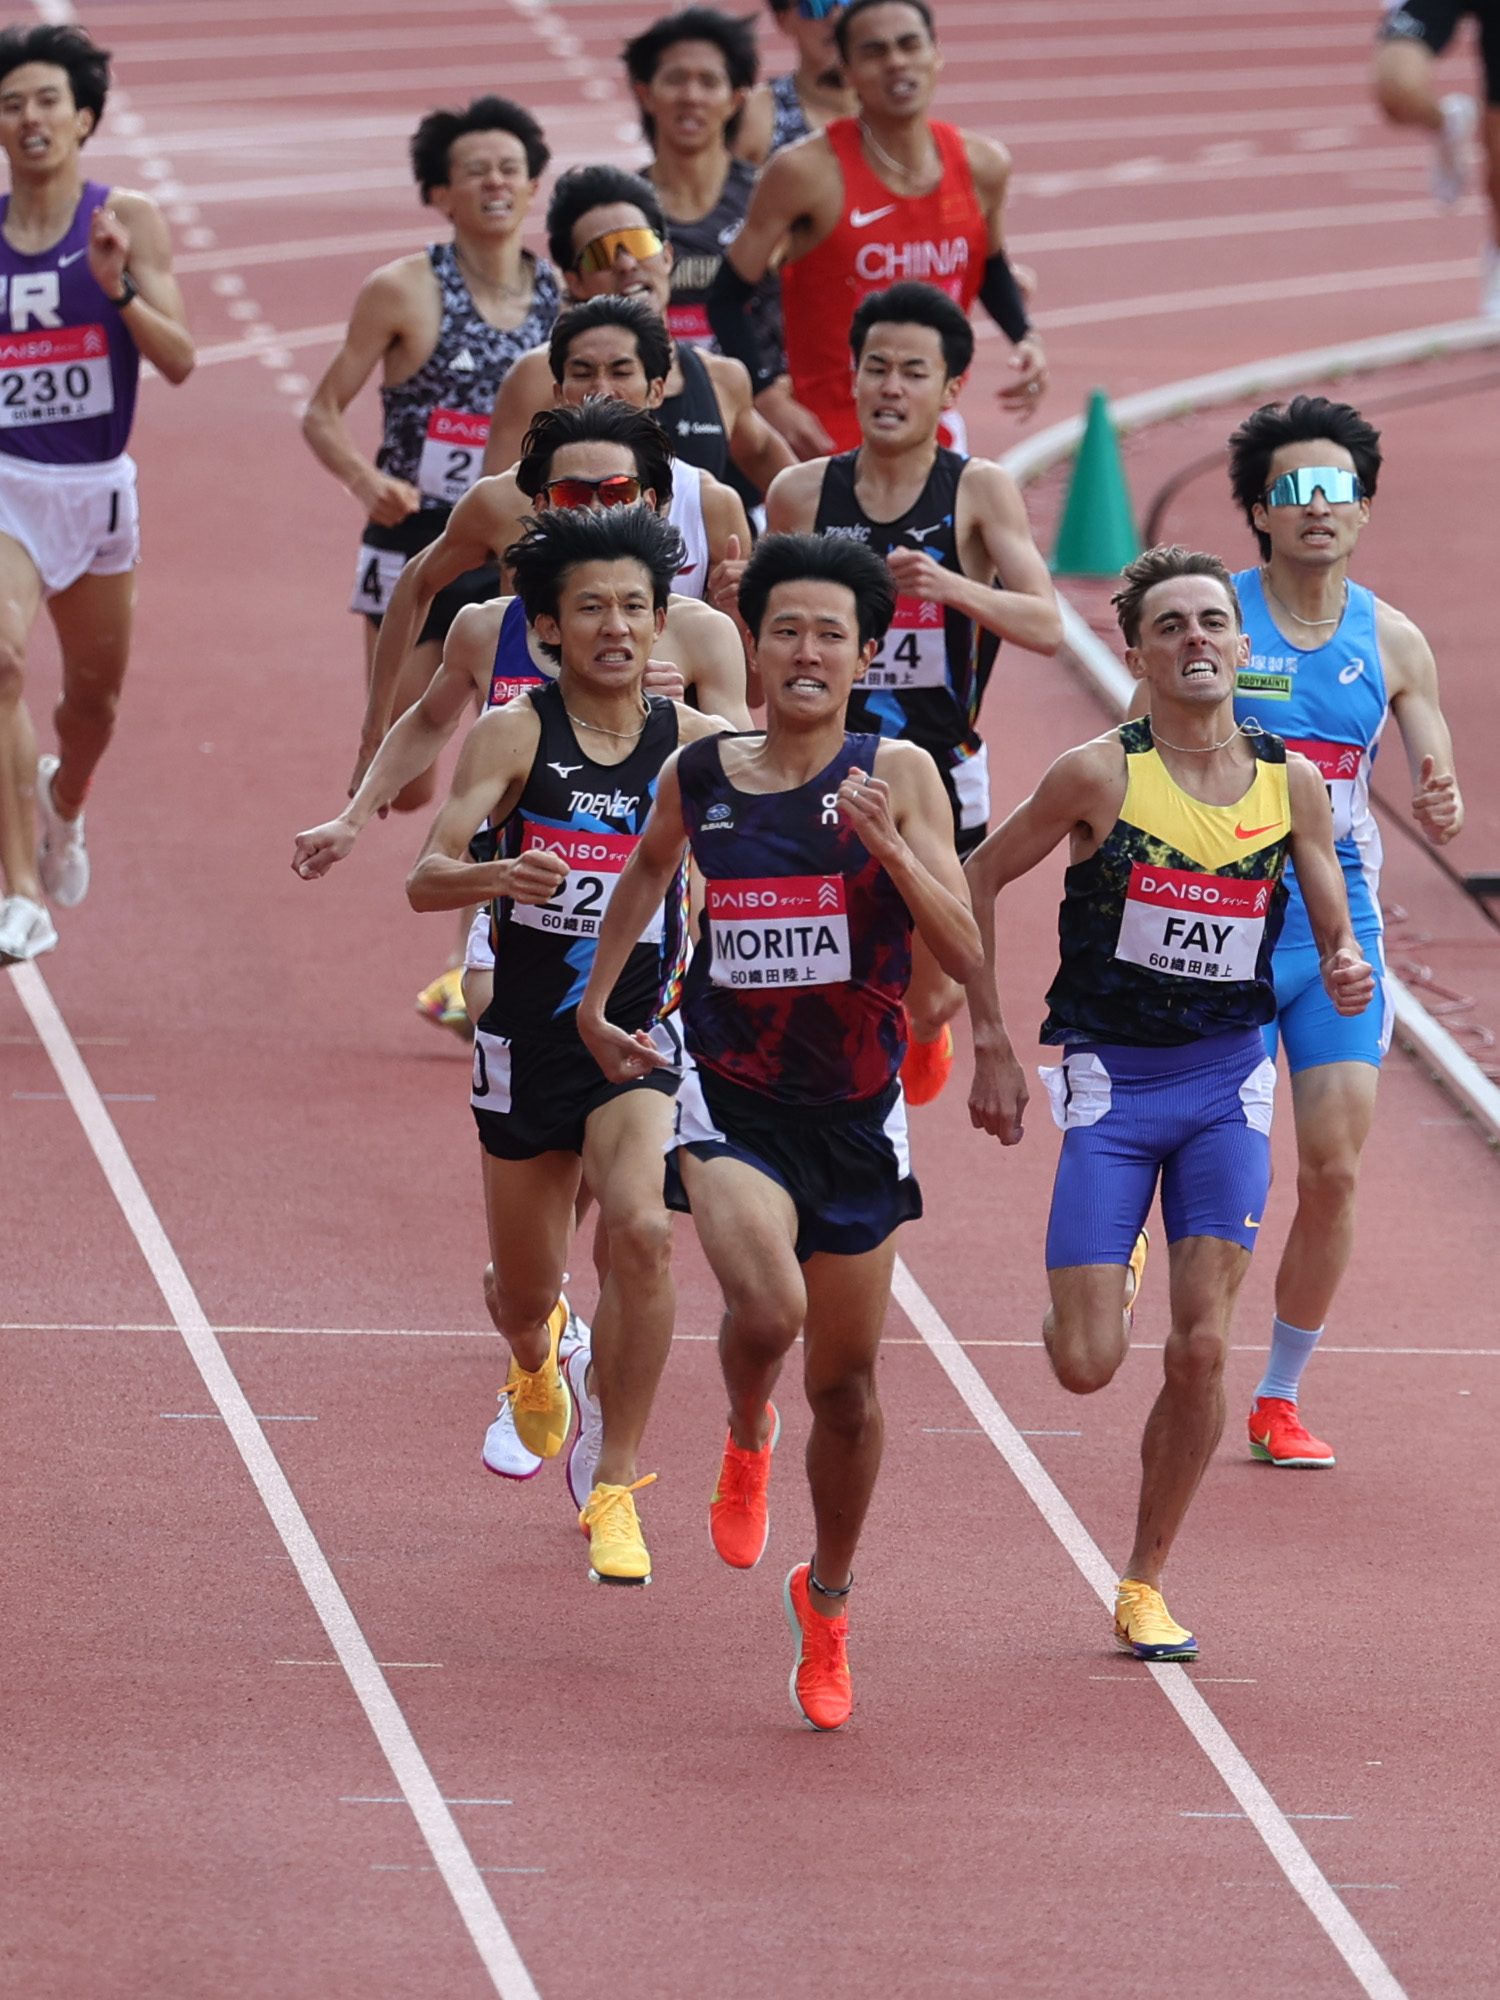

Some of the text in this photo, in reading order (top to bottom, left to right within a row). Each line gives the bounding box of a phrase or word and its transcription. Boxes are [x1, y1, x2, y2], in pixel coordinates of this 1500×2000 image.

[855, 236, 968, 280] CHINA
[2, 365, 91, 406] 230
[436, 417, 490, 440] DAIS
[362, 558, 383, 604] 4
[567, 788, 640, 820] TOENEC
[700, 821, 734, 831] SUBARU
[712, 891, 777, 908] DAISO
[1140, 876, 1220, 904] DAISO
[541, 914, 601, 934] 60織田
[1162, 916, 1235, 955] FAY
[716, 925, 840, 961] MORITA
[731, 967, 817, 985] 60織田陸上
[1148, 952, 1233, 978] 60織田陸上
